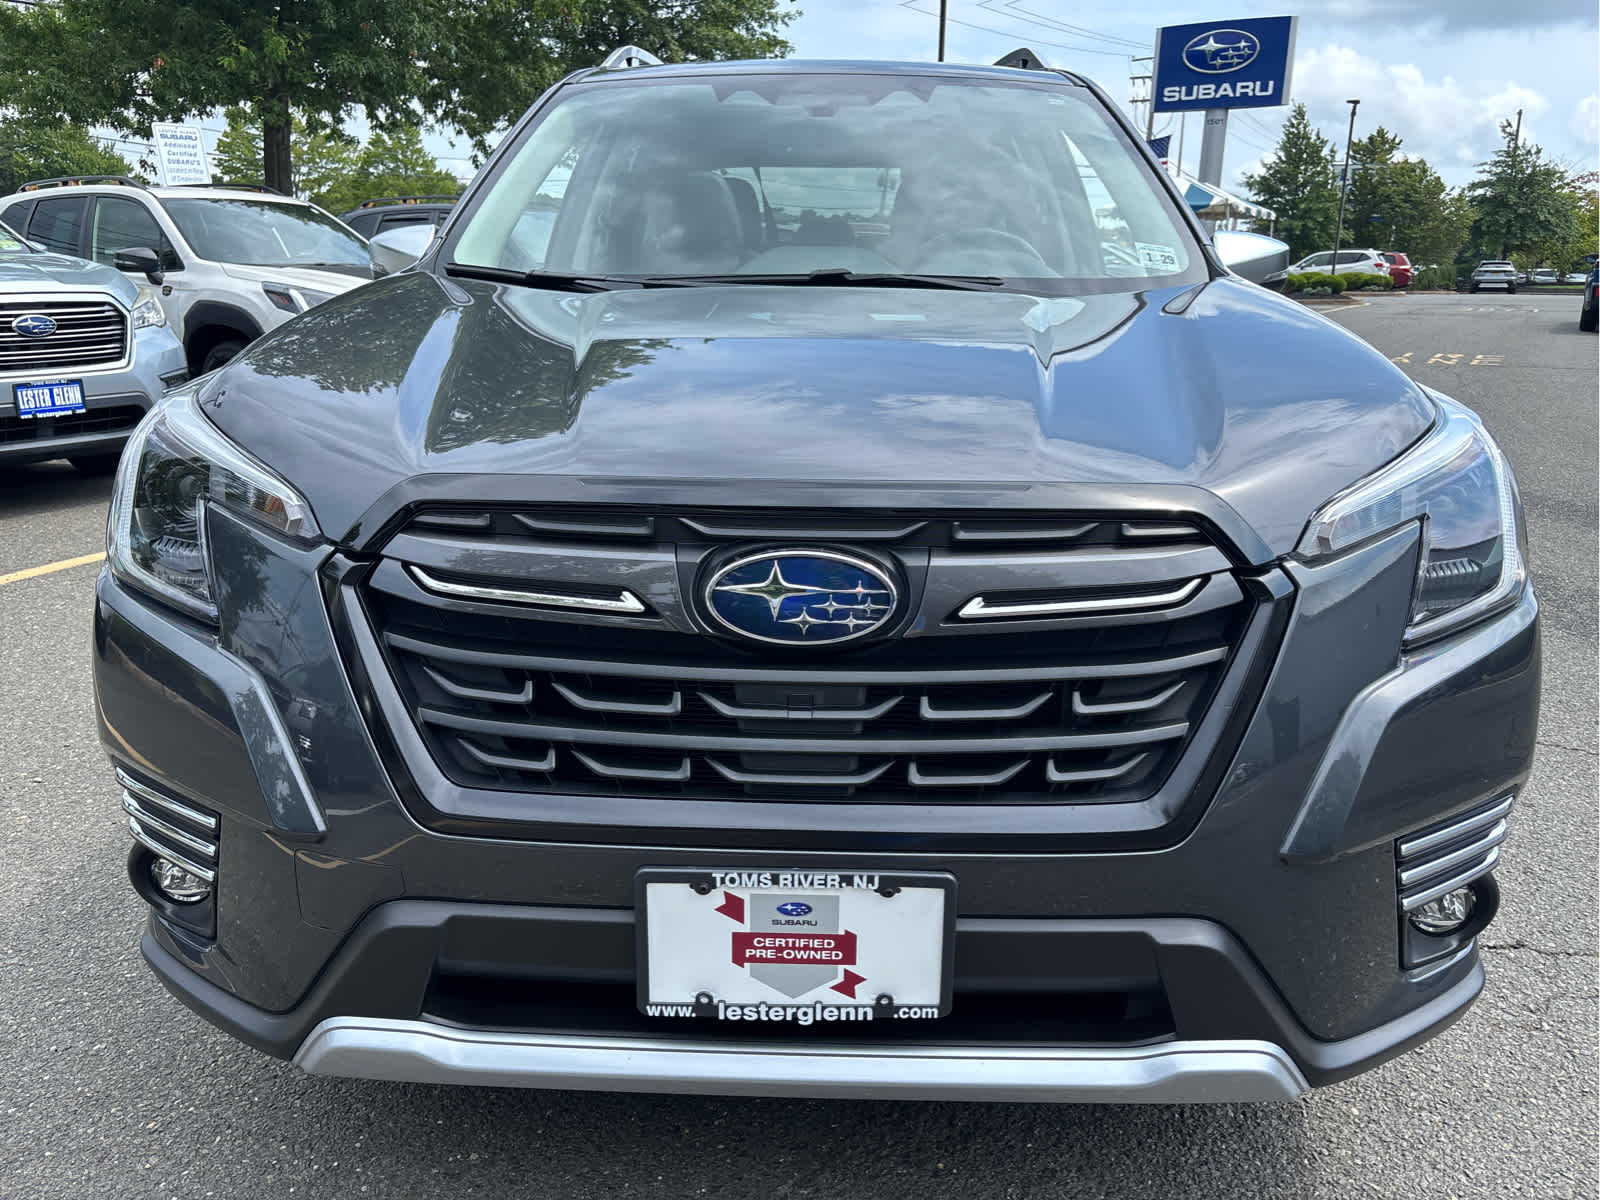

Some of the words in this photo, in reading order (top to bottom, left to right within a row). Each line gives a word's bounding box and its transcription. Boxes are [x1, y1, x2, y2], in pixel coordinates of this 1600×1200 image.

[1163, 80, 1275, 102] SUBARU
[160, 133, 197, 141] SUBARU
[17, 388, 52, 409] LESTER
[53, 385, 82, 406] GLENN
[711, 872, 773, 888] TOMS
[853, 874, 880, 890] NJ
[771, 919, 818, 927] SUBARU
[753, 937, 835, 949] CERTIFIED
[745, 949, 843, 961] PRE-OWNED
[646, 1005, 697, 1018] www.
[718, 1002, 873, 1026] lesterglenn
[893, 1006, 939, 1019] .com
